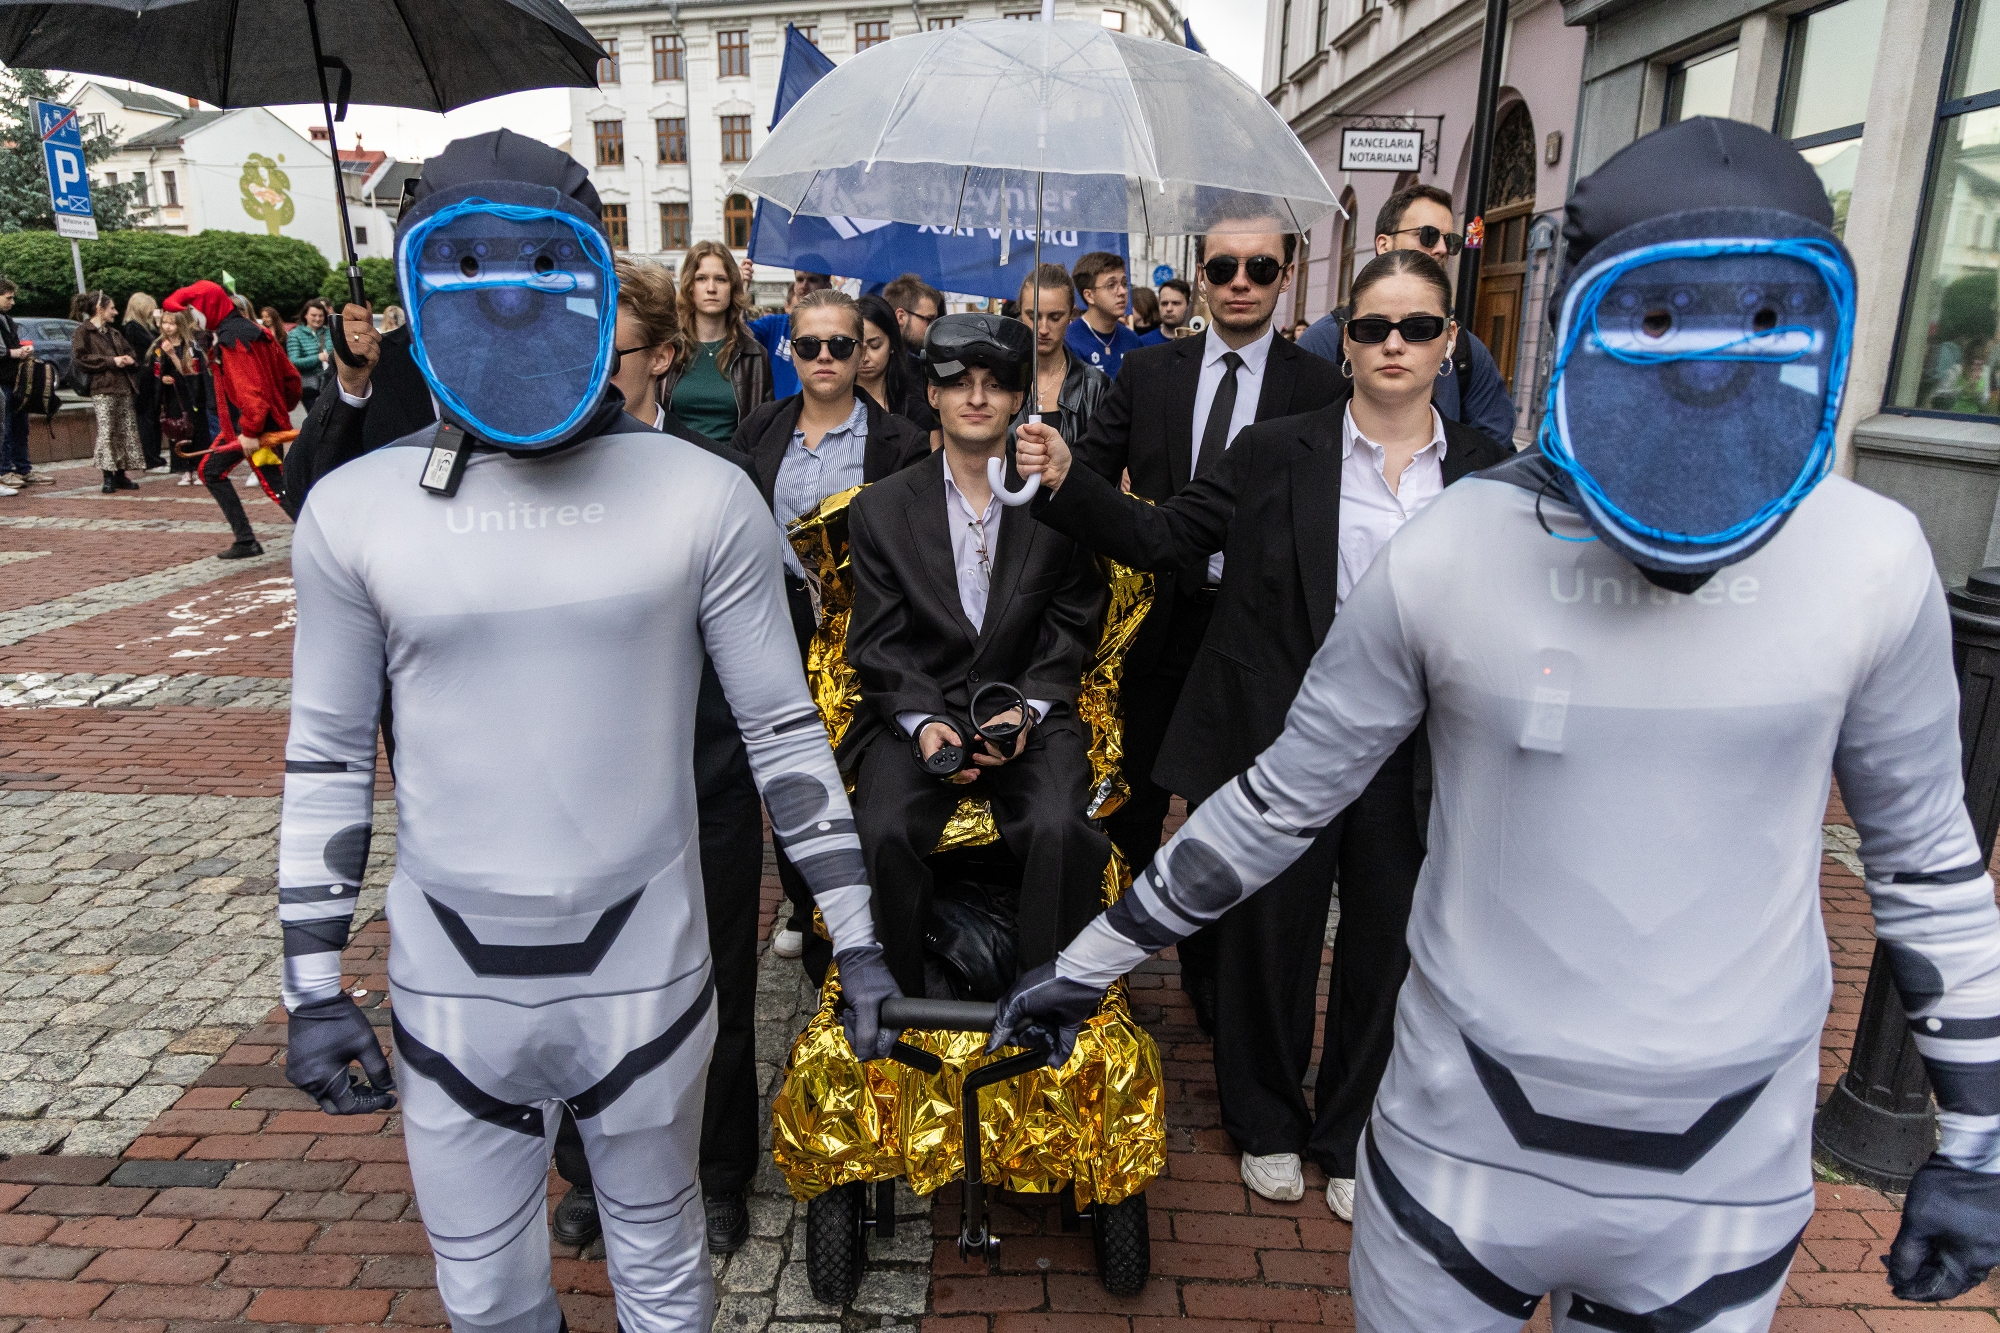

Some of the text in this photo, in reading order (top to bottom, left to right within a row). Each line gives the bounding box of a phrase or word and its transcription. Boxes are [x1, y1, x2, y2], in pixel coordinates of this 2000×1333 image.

[1349, 137, 1414, 149] KANCELARIA
[1349, 151, 1413, 163] NOTARIALNA
[54, 149, 80, 194] P
[446, 501, 605, 534] Unitree
